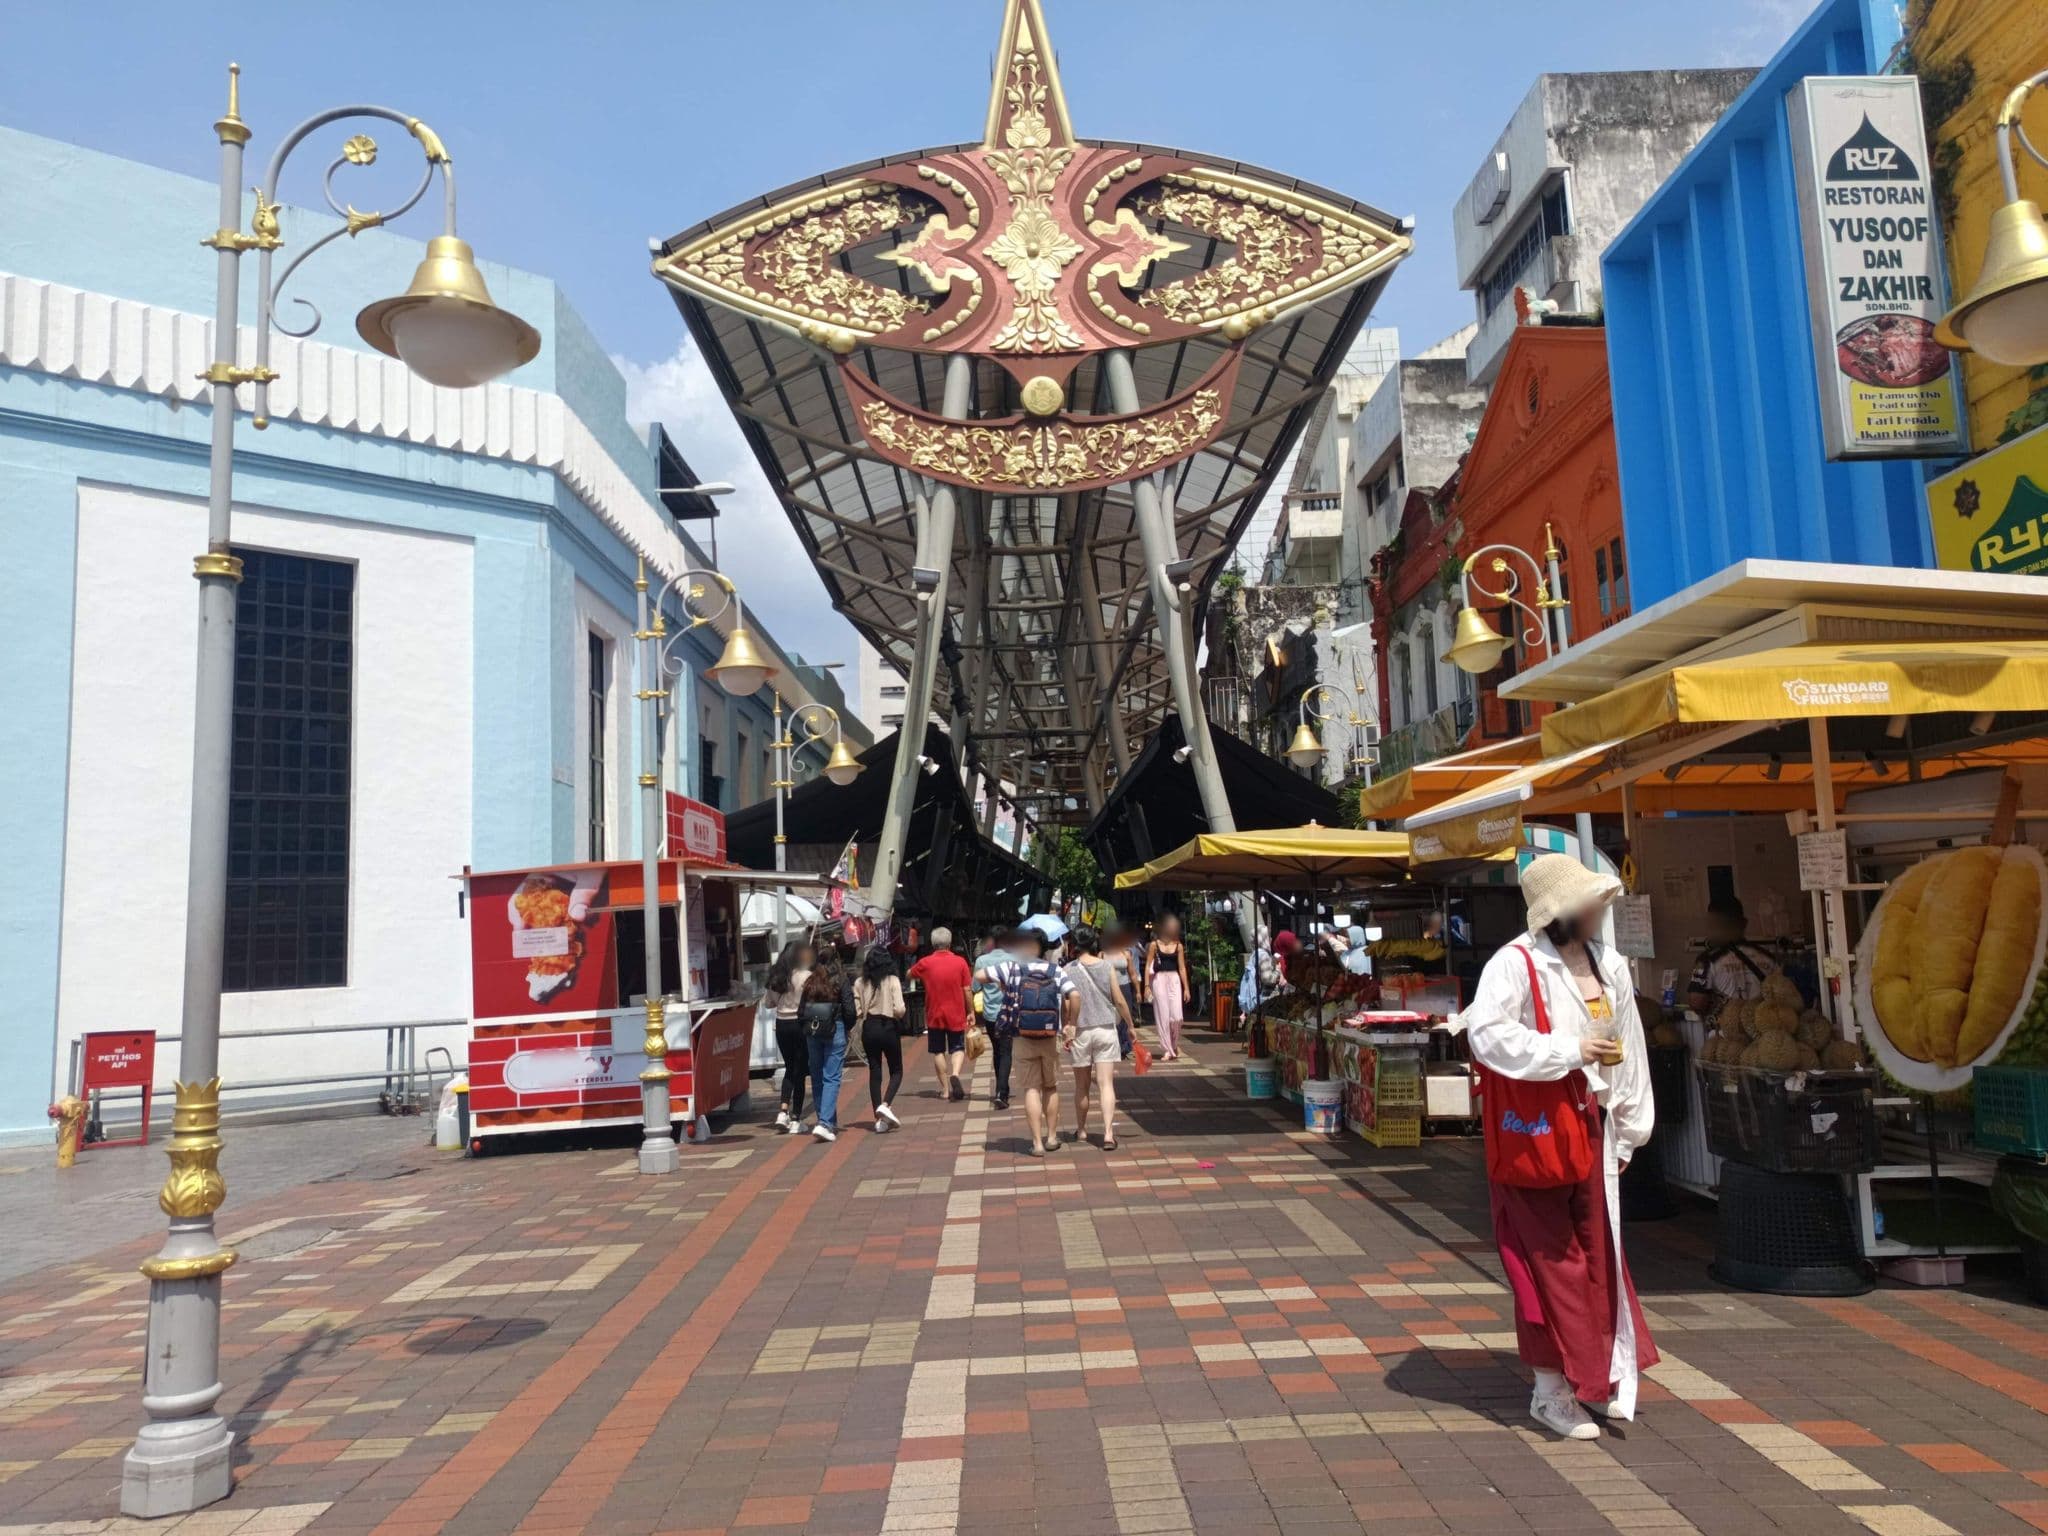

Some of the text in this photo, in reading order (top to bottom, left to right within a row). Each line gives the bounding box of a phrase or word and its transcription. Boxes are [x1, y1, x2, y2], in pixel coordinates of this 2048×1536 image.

[1825, 186, 1926, 206] RESTORAN
[1828, 217, 1929, 243] YUSOOF
[1863, 249, 1903, 269] DAN
[1838, 275, 1934, 301] ZAKHIR
[1860, 428, 1949, 440] Ikan Istimewa
[1809, 681, 1889, 694] STANDARD
[1801, 693, 1852, 705] FRUITS
[111, 1061, 128, 1069] API
